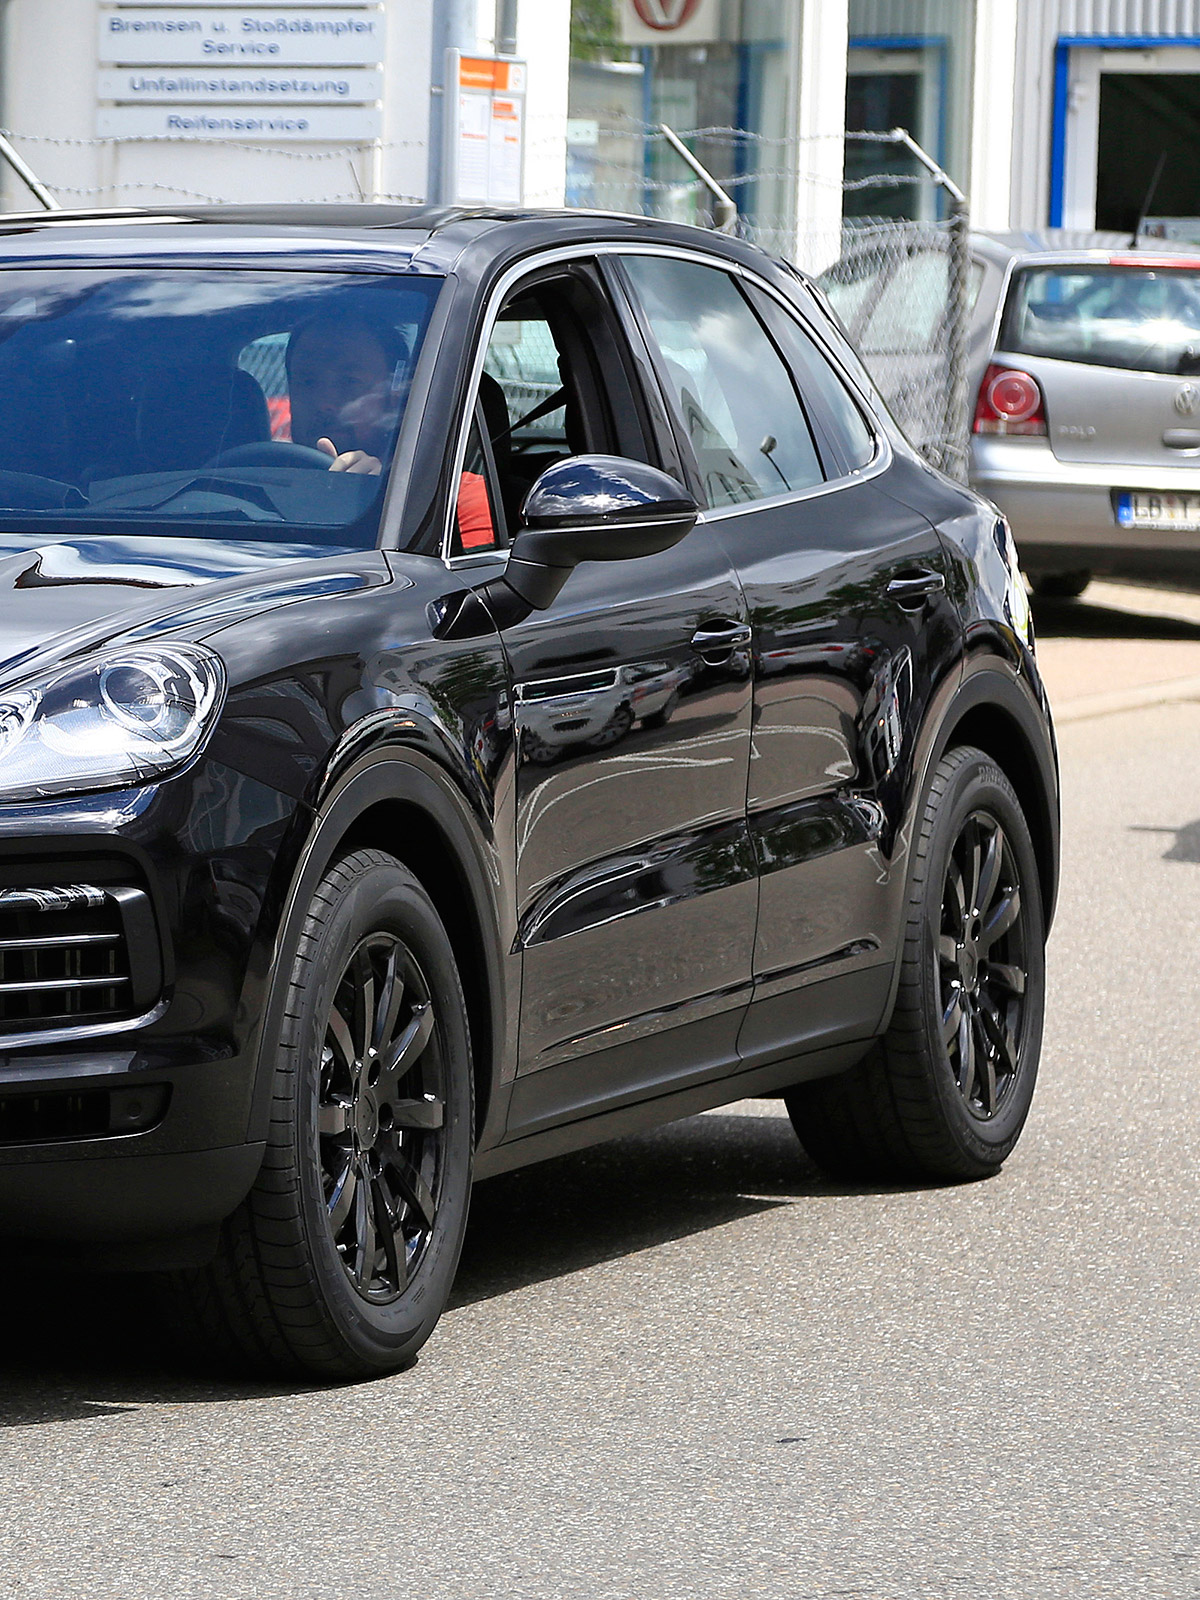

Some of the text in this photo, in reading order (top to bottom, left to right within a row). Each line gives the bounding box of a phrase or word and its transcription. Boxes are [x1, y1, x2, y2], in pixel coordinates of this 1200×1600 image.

[109, 17, 375, 35] Bremsen u. Stoßdämpfer
[202, 39, 280, 53] Service
[129, 77, 349, 95] Unfallinstandsetzung
[167, 115, 309, 130] Reifenservice
